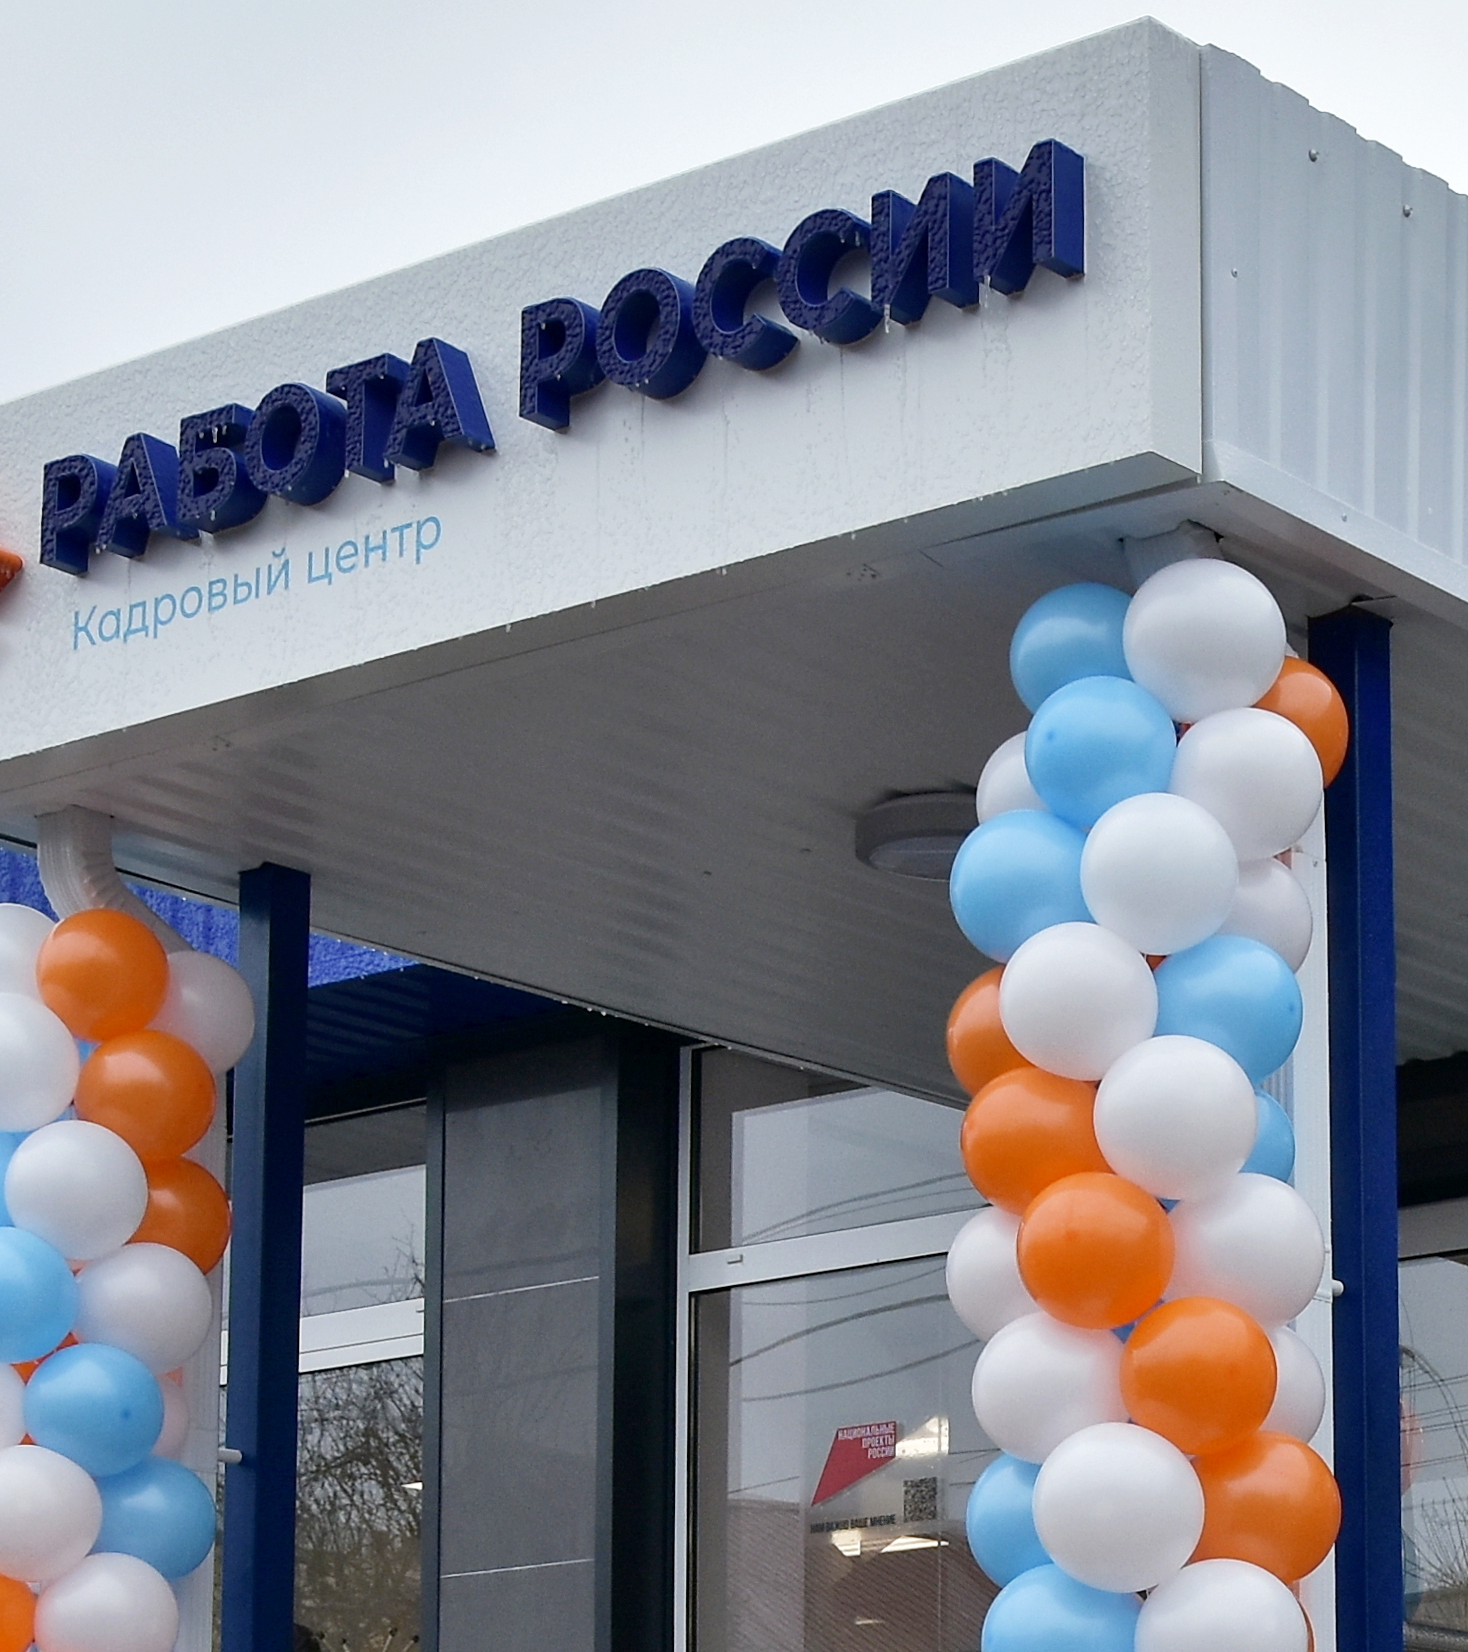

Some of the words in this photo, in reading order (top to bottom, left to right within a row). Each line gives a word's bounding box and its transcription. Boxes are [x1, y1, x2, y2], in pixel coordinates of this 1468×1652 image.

[39, 336, 498, 577] РАБОТА
[519, 138, 1086, 433] РОССИИ
[73, 546, 291, 651] Кадровый
[306, 514, 443, 586] центр
[838, 1423, 895, 1440] НАЦИОНАЛЬНЫЕ
[862, 1435, 894, 1448] ПРОЕКТЫ
[868, 1447, 895, 1459] РОССИИ
